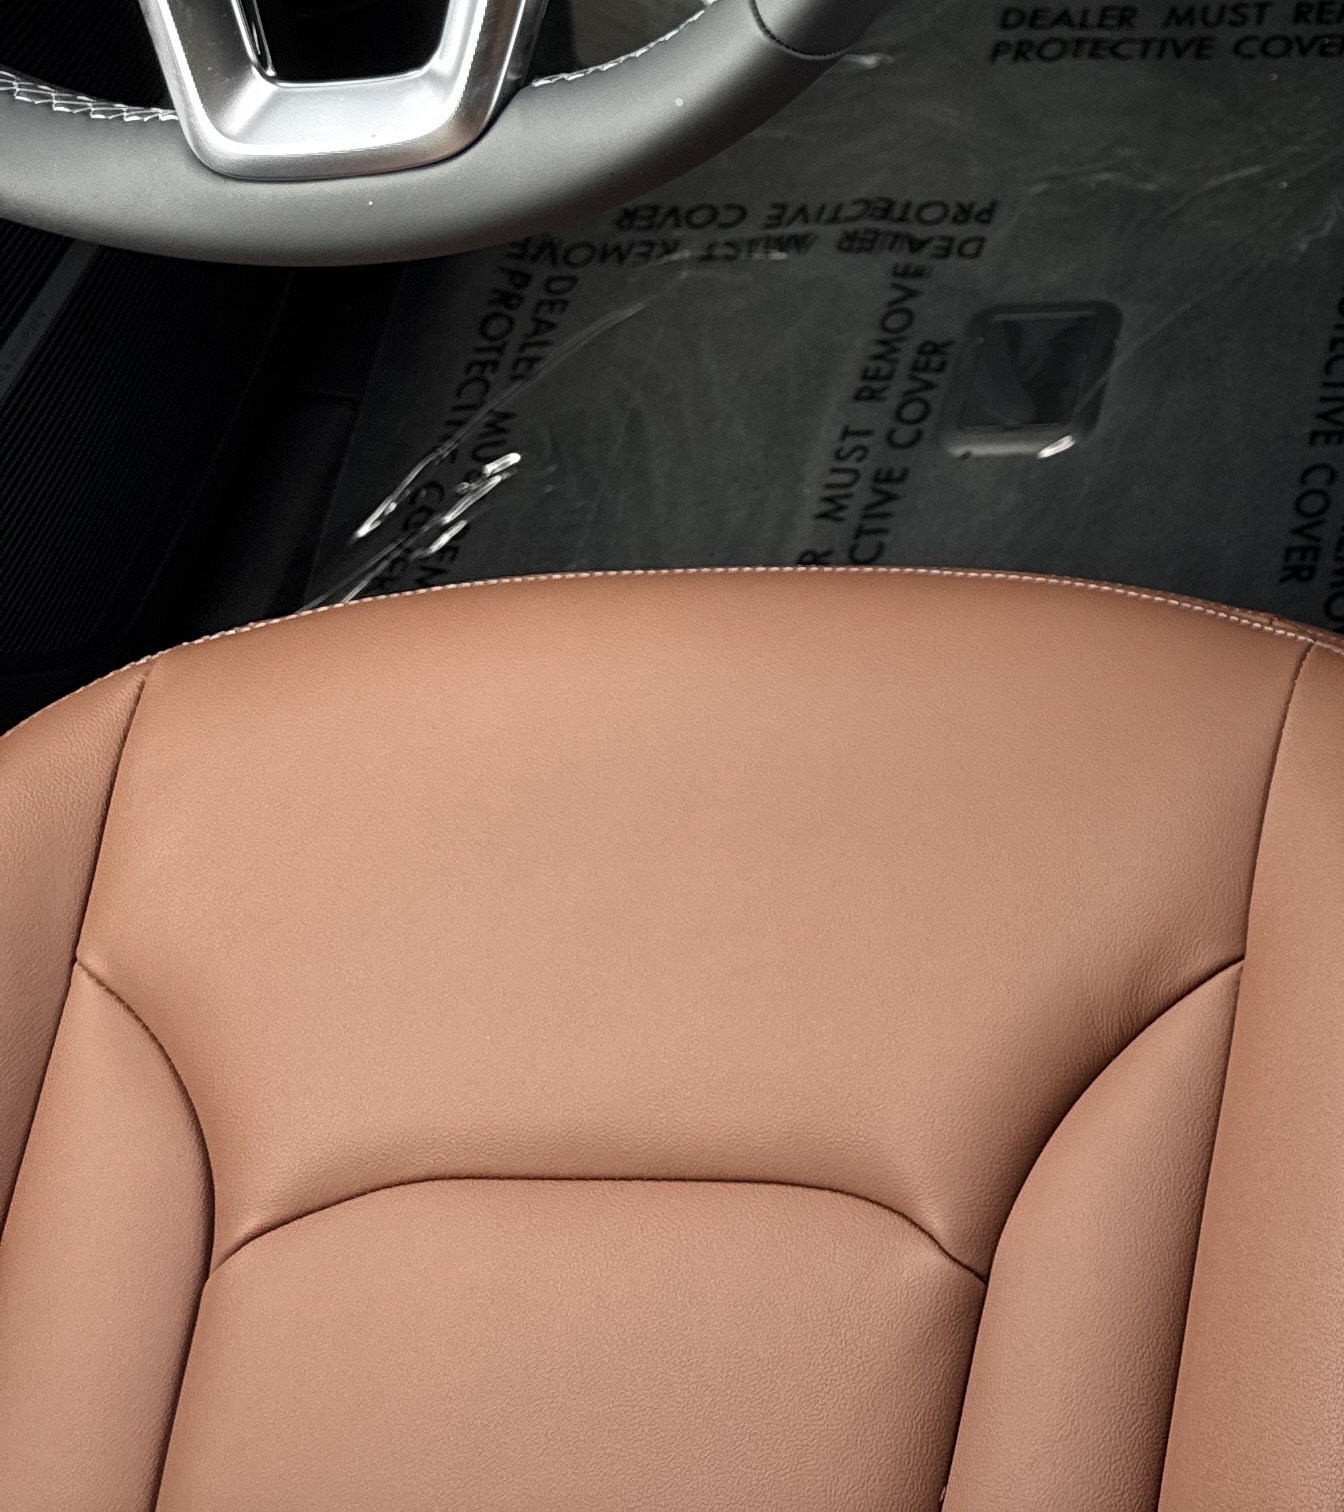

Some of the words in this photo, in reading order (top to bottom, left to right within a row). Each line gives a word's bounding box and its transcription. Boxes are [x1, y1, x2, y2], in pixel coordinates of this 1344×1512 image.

[999, 6, 1138, 31] DEALER
[1163, 1, 1274, 27] MUST
[988, 36, 1213, 65] PROTECTIVE
[614, 203, 748, 232] COVER
[762, 197, 998, 228] PROTECTIVE
[836, 228, 987, 260] DEALER
[815, 424, 876, 525] MUST
[853, 262, 934, 405] REMOVE
[886, 338, 954, 451] COVER
[1279, 461, 1339, 585] COVER
